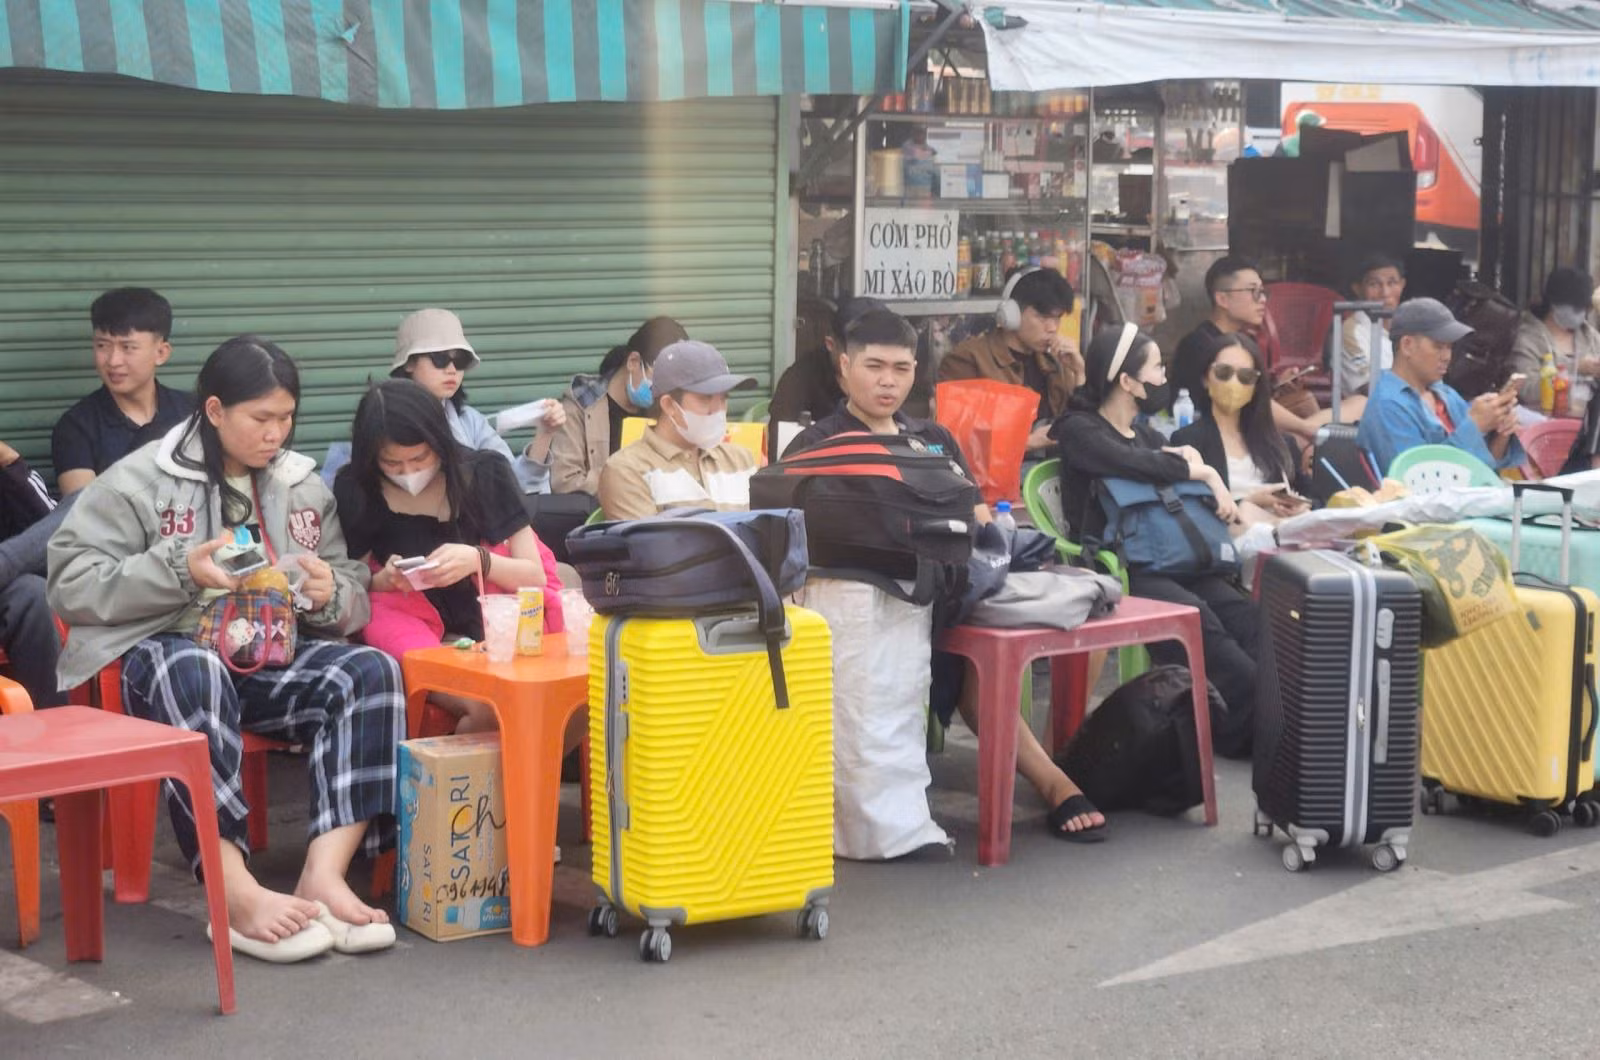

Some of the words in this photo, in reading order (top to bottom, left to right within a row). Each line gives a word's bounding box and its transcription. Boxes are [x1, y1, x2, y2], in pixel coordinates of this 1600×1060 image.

[870, 218, 908, 249] CƠM
[914, 213, 952, 250] PHỞ
[863, 261, 886, 295] MÌ
[891, 261, 926, 295] XÀO
[932, 261, 955, 295] BÒ
[160, 507, 195, 538] 33
[289, 510, 316, 529] UP
